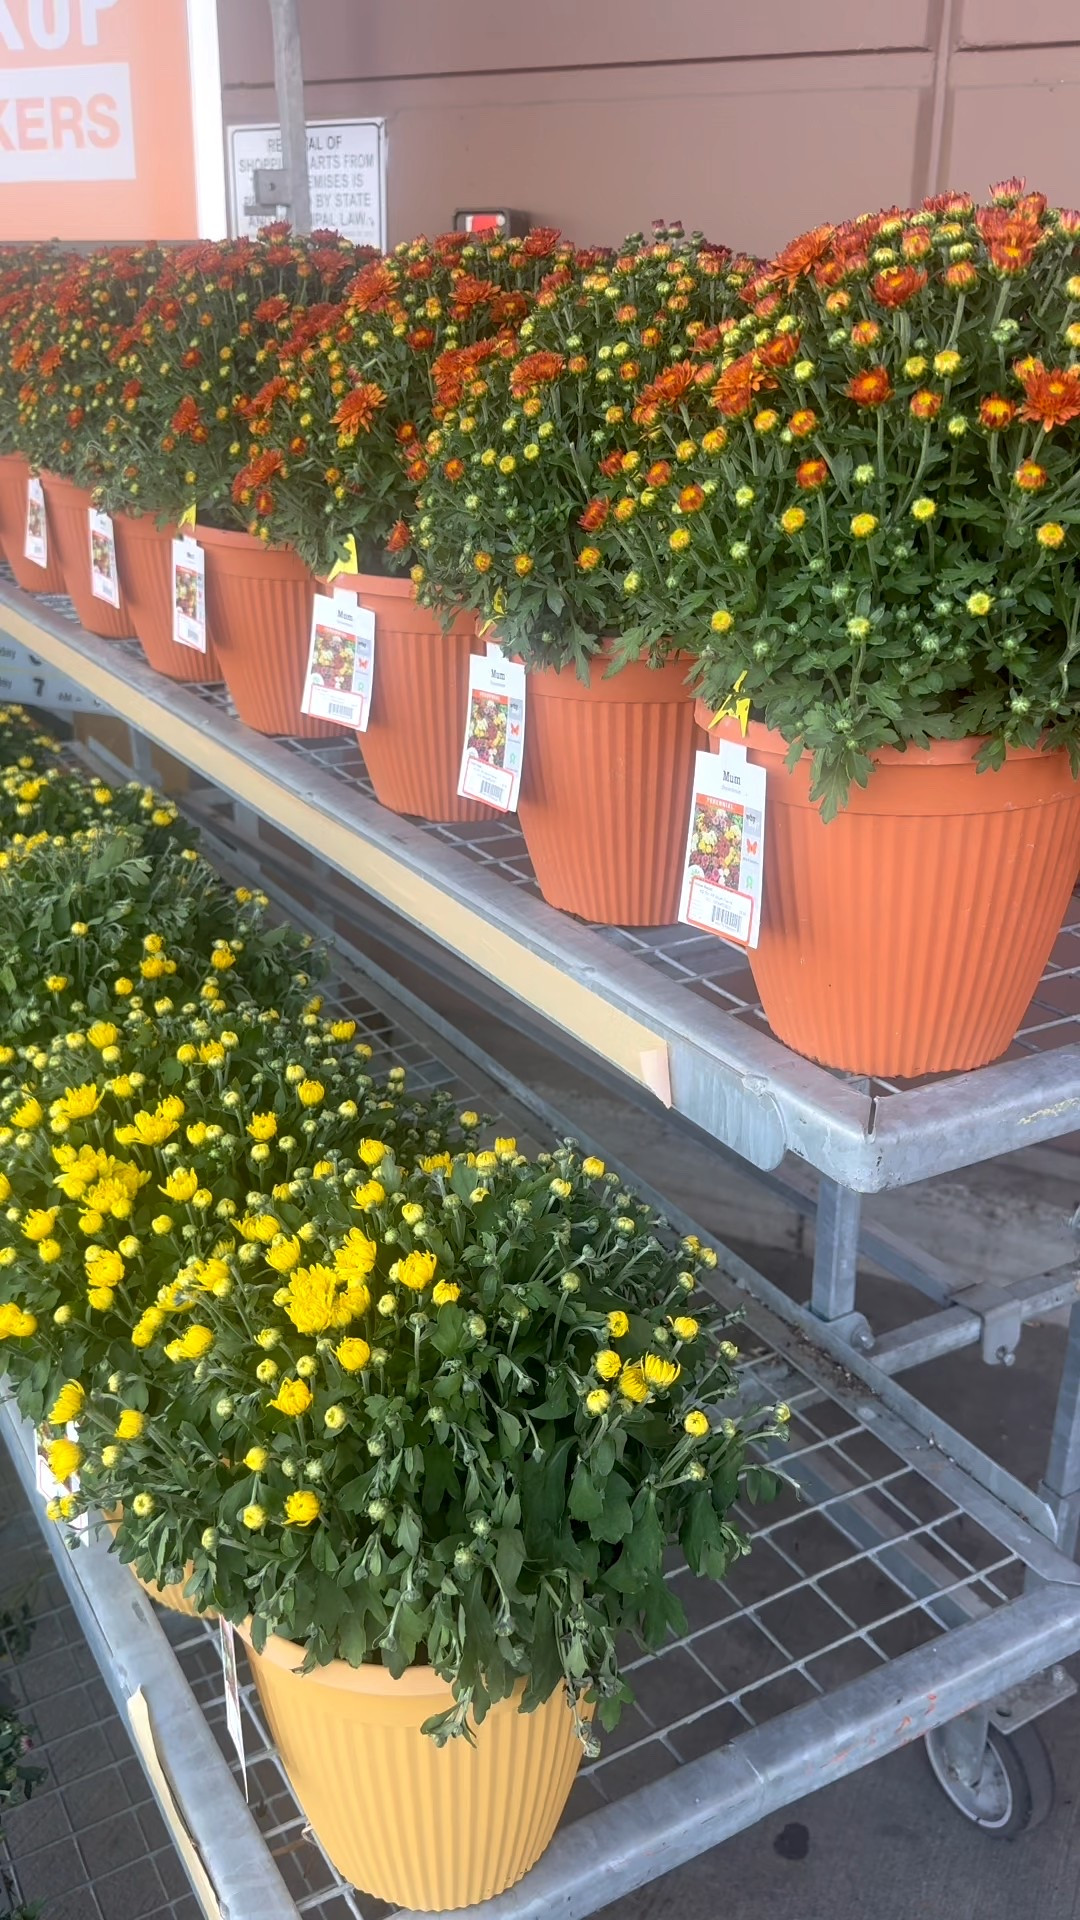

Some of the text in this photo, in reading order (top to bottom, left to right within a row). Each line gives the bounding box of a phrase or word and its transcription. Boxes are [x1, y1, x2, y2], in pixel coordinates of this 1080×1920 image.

[327, 135, 343, 150] OF
[310, 155, 341, 170] ARTS
[344, 153, 374, 169] FROM
[352, 173, 364, 188] IS
[316, 192, 371, 208] BY STATE
[33, 677, 45, 697] 7
[722, 770, 741, 785] Mum
